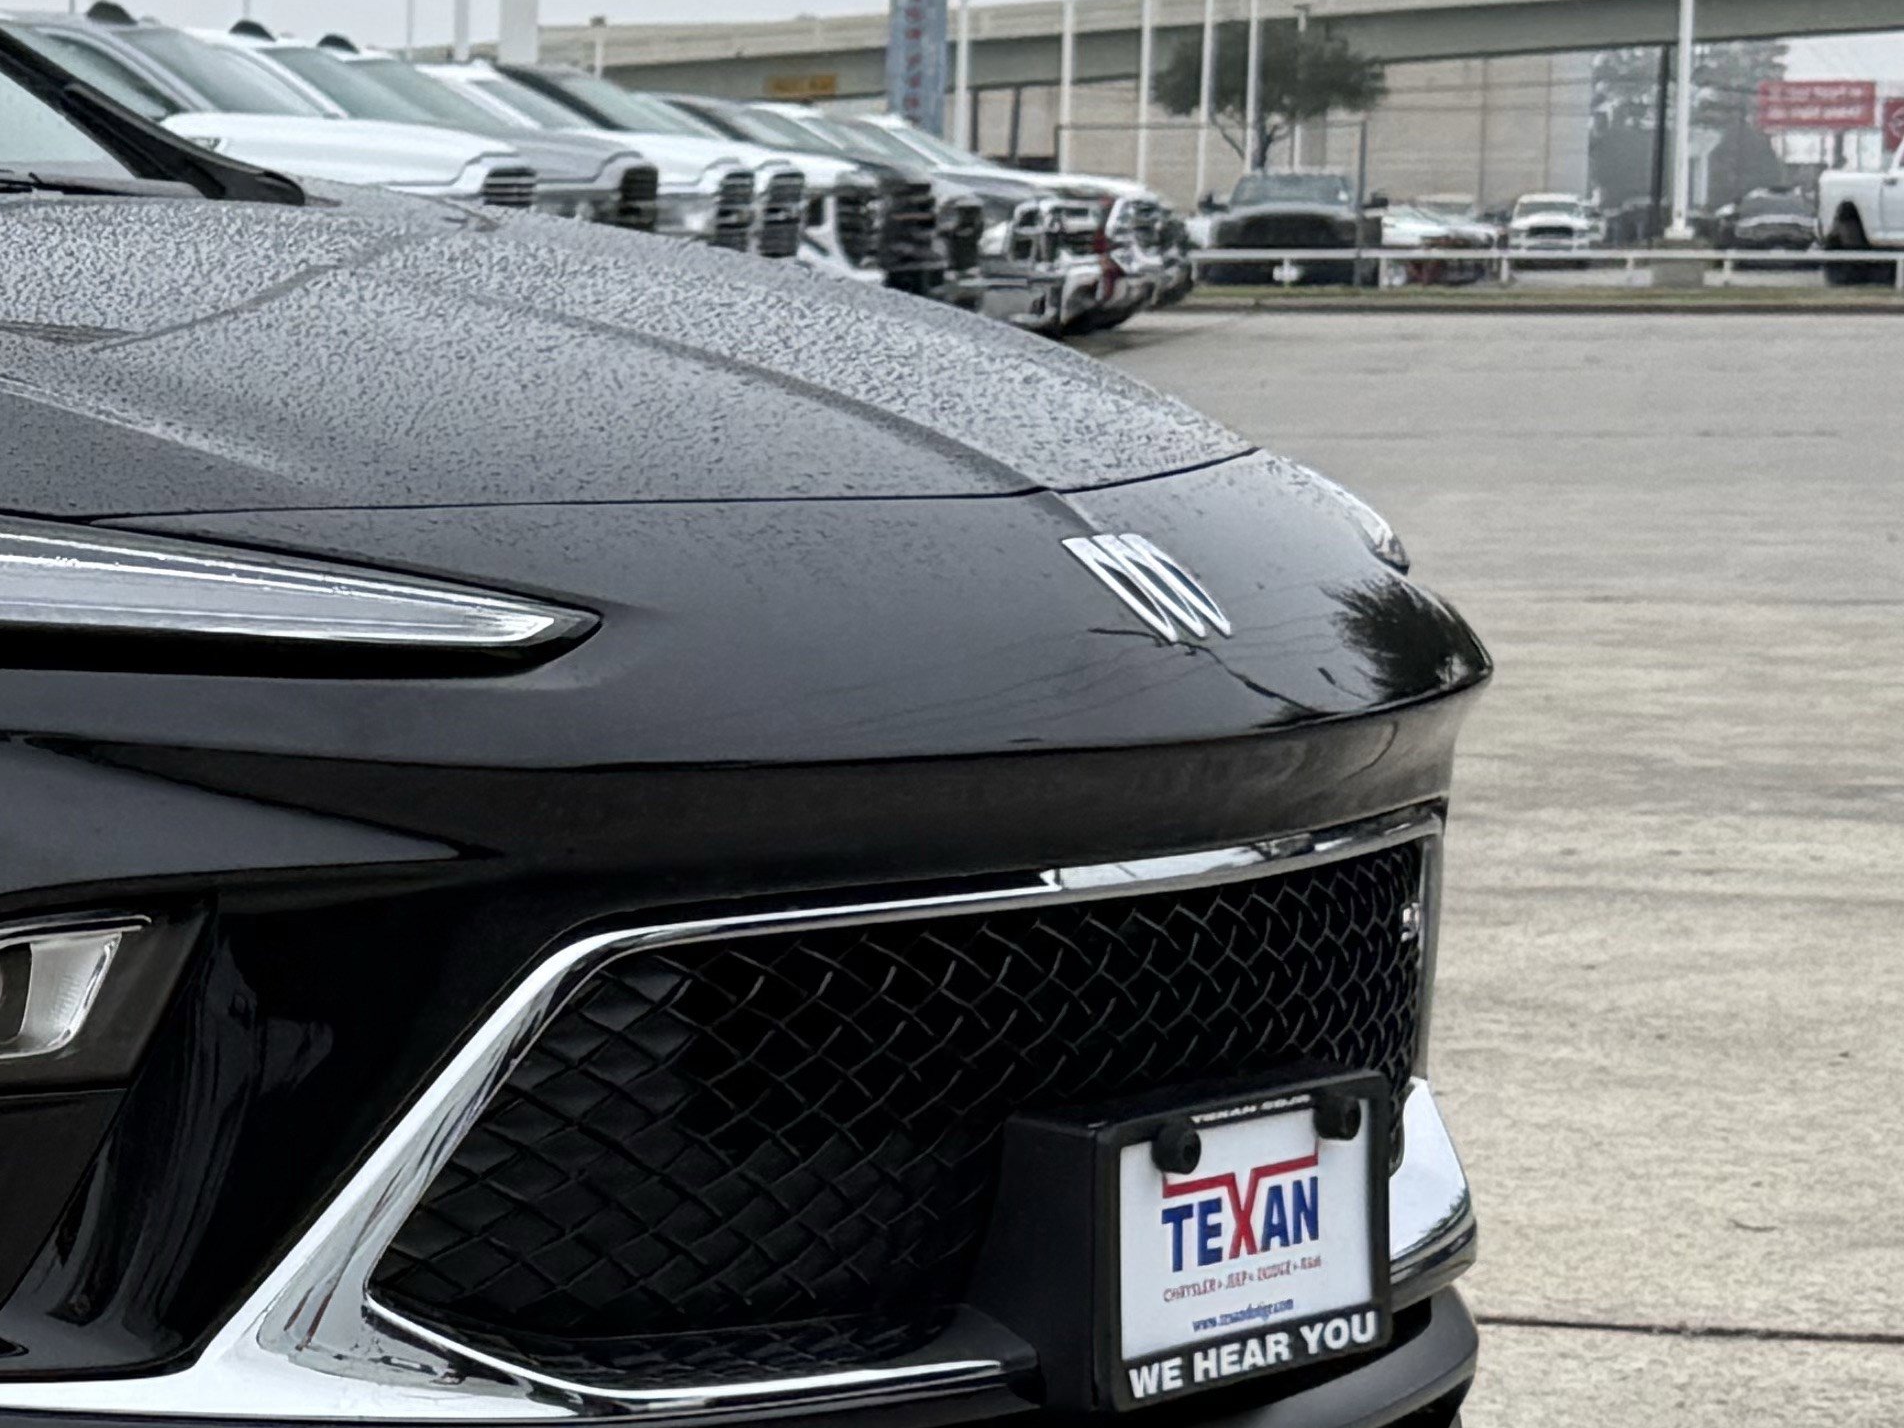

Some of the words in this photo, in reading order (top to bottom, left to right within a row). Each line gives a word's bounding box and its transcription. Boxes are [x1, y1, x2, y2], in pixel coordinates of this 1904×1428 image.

[1161, 1170, 1319, 1272] TEXAN
[1129, 1358, 1184, 1400] WE
[1193, 1332, 1290, 1384] HEAR
[1300, 1310, 1378, 1355] YOU
